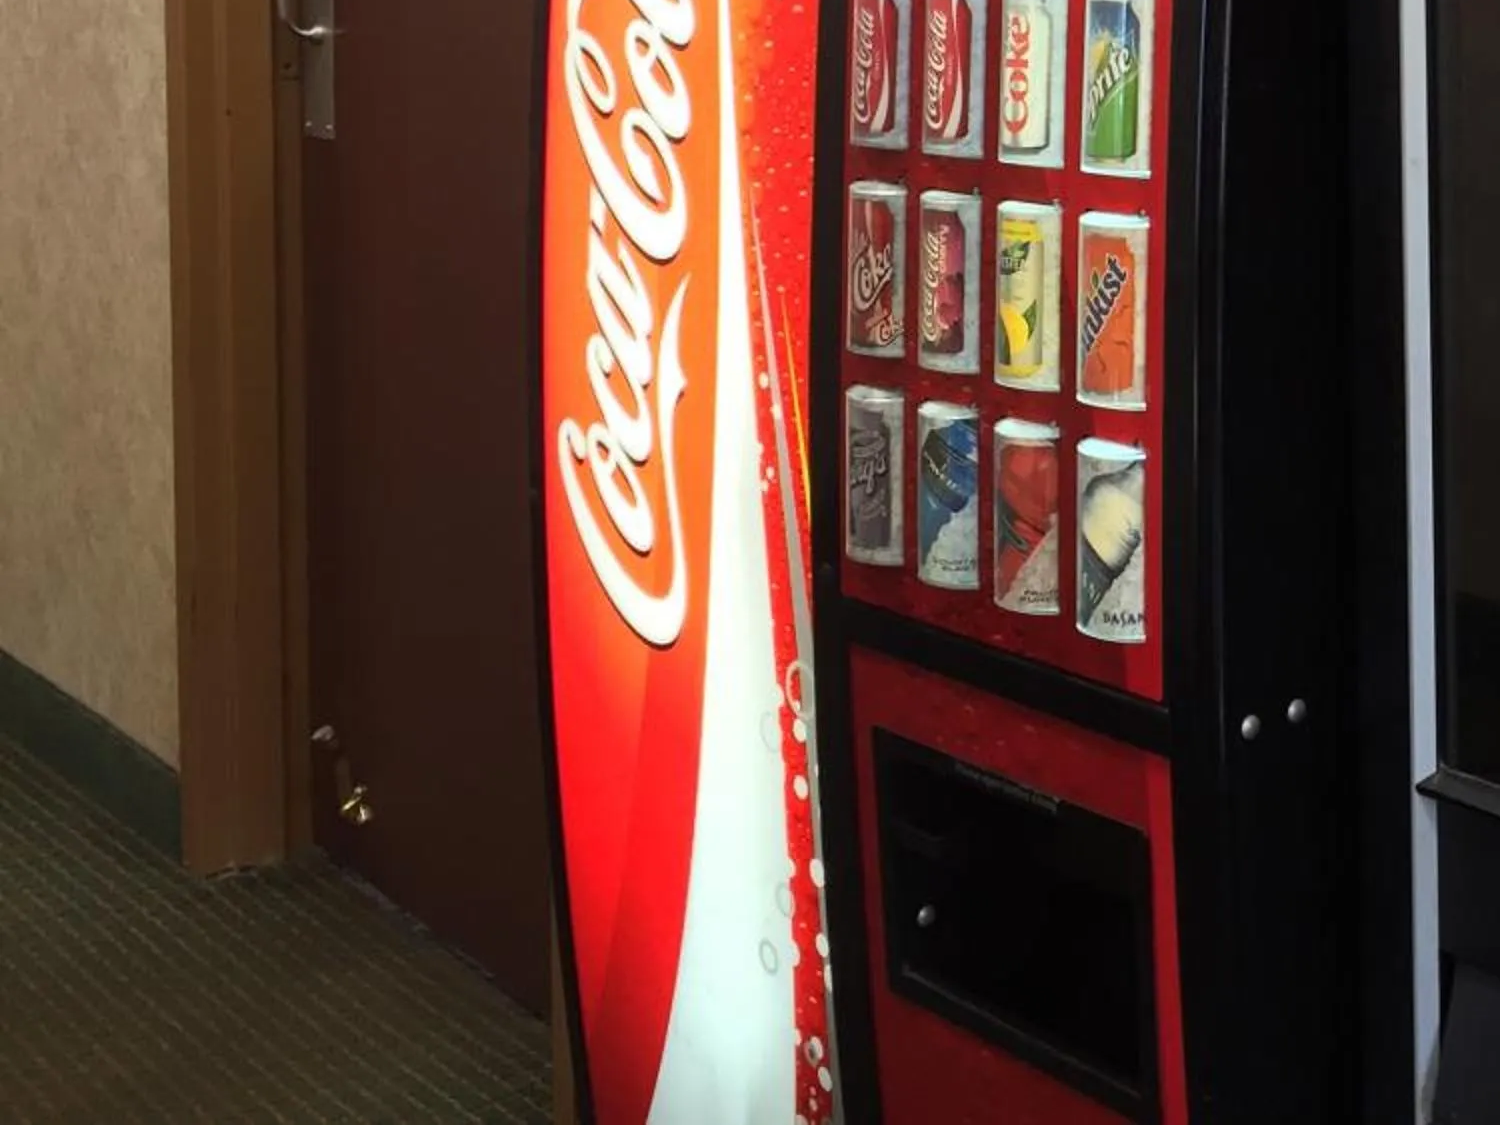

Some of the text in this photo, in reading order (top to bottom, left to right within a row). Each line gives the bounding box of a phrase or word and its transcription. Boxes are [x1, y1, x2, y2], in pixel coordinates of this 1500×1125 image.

[854, 10, 875, 124] Coca-Cola
[923, 10, 948, 130] Coca-Cola
[922, 230, 941, 343] Coca-Cola
